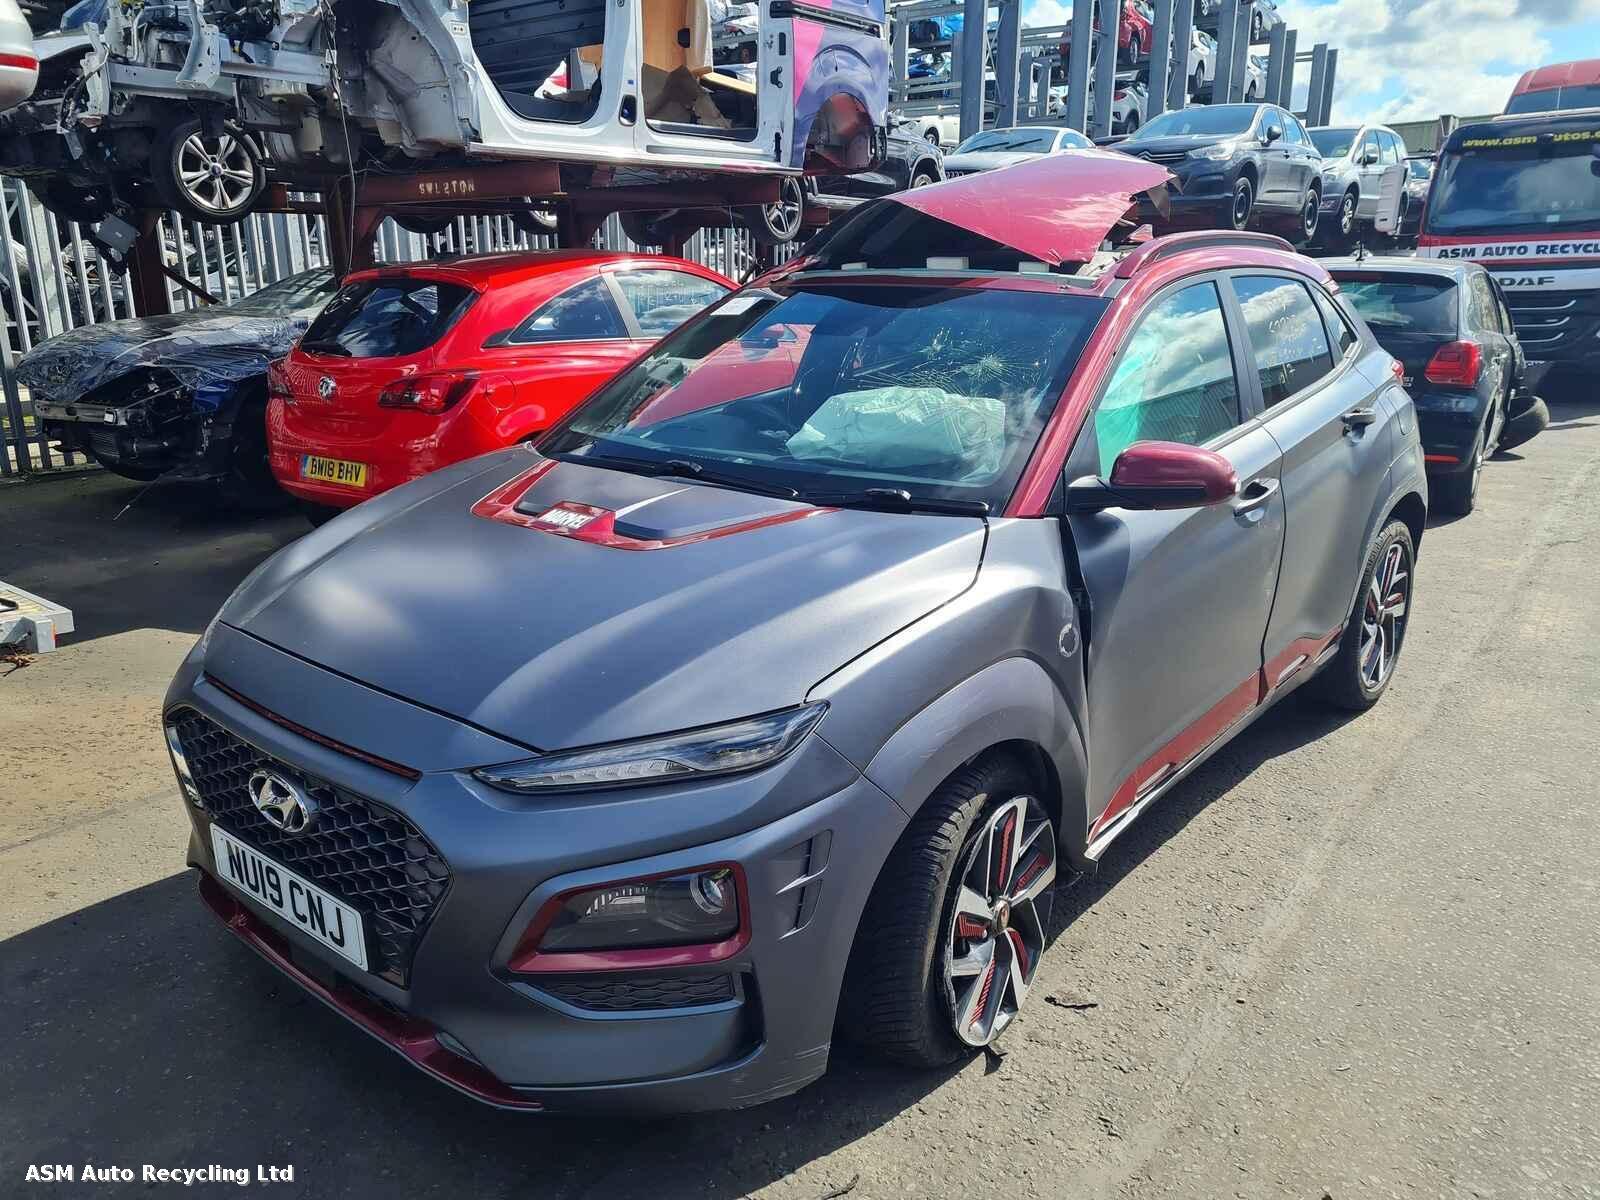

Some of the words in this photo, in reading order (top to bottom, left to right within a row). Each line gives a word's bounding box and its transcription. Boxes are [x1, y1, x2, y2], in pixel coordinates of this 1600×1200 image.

[1438, 247, 1475, 259] ASM
[1482, 245, 1528, 257] AUTO
[1500, 276, 1555, 286] DAF
[337, 462, 361, 482] BHV
[540, 509, 593, 529] MARVEL
[225, 839, 284, 909] NU19
[288, 879, 345, 948] CNJ
